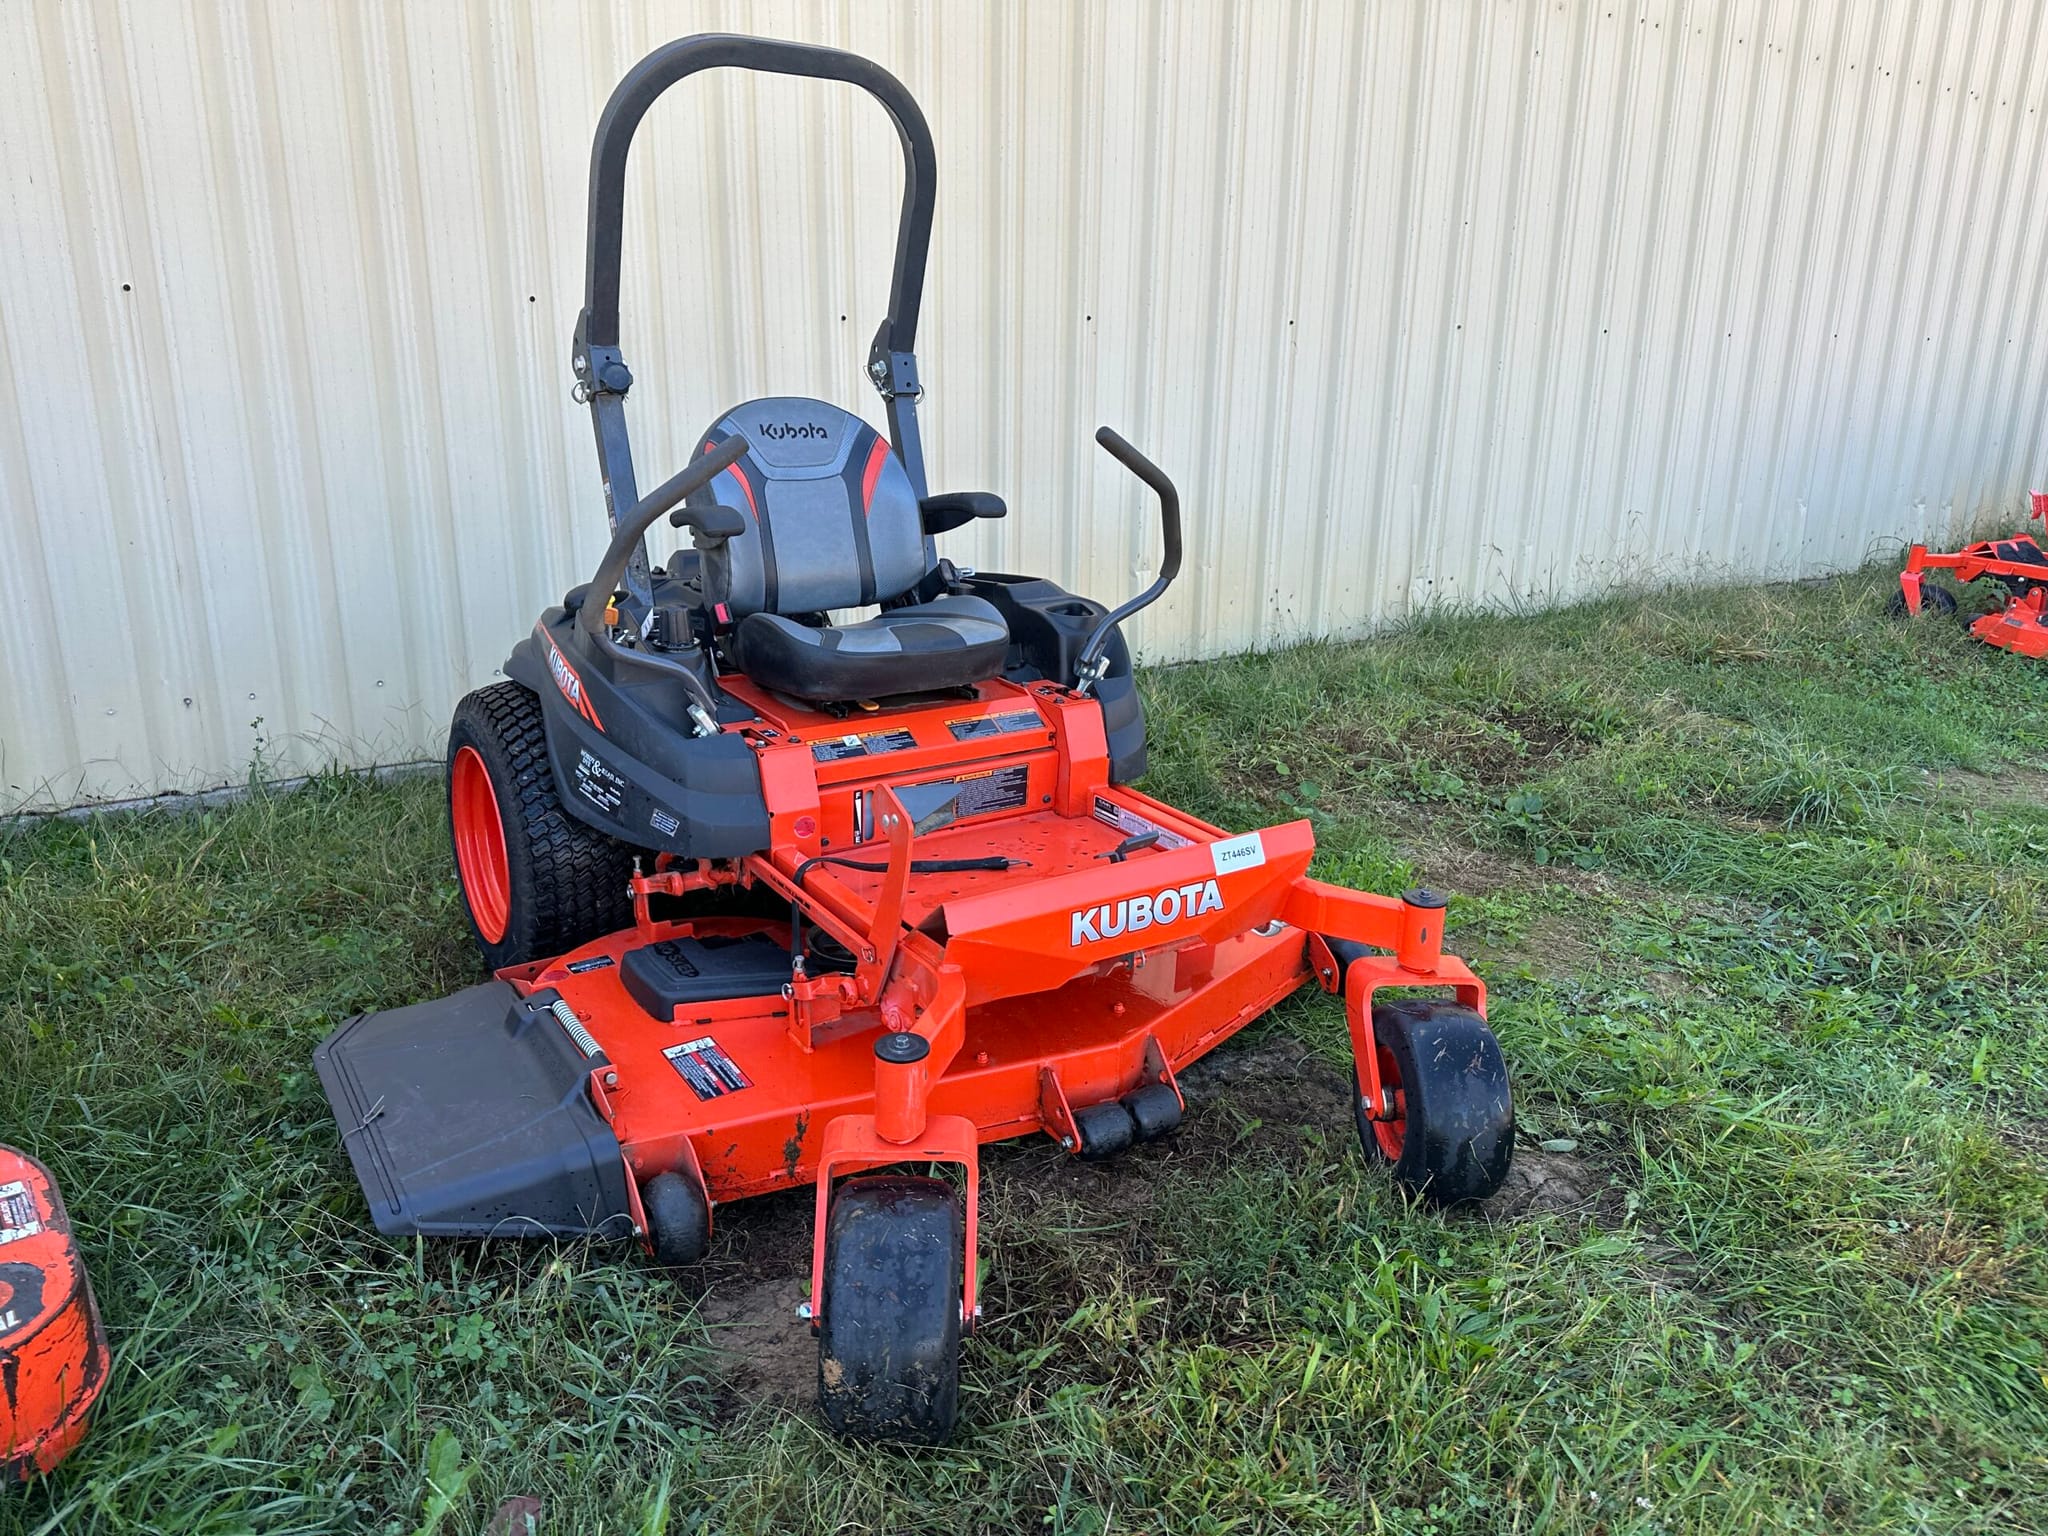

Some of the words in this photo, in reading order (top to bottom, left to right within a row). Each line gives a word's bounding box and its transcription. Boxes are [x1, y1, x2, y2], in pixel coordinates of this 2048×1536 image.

[759, 422, 828, 440] Kubota
[548, 645, 580, 705] KUBOTA
[1221, 845, 1257, 862] ZT446SV
[1071, 879, 1225, 947] KUBOTA
